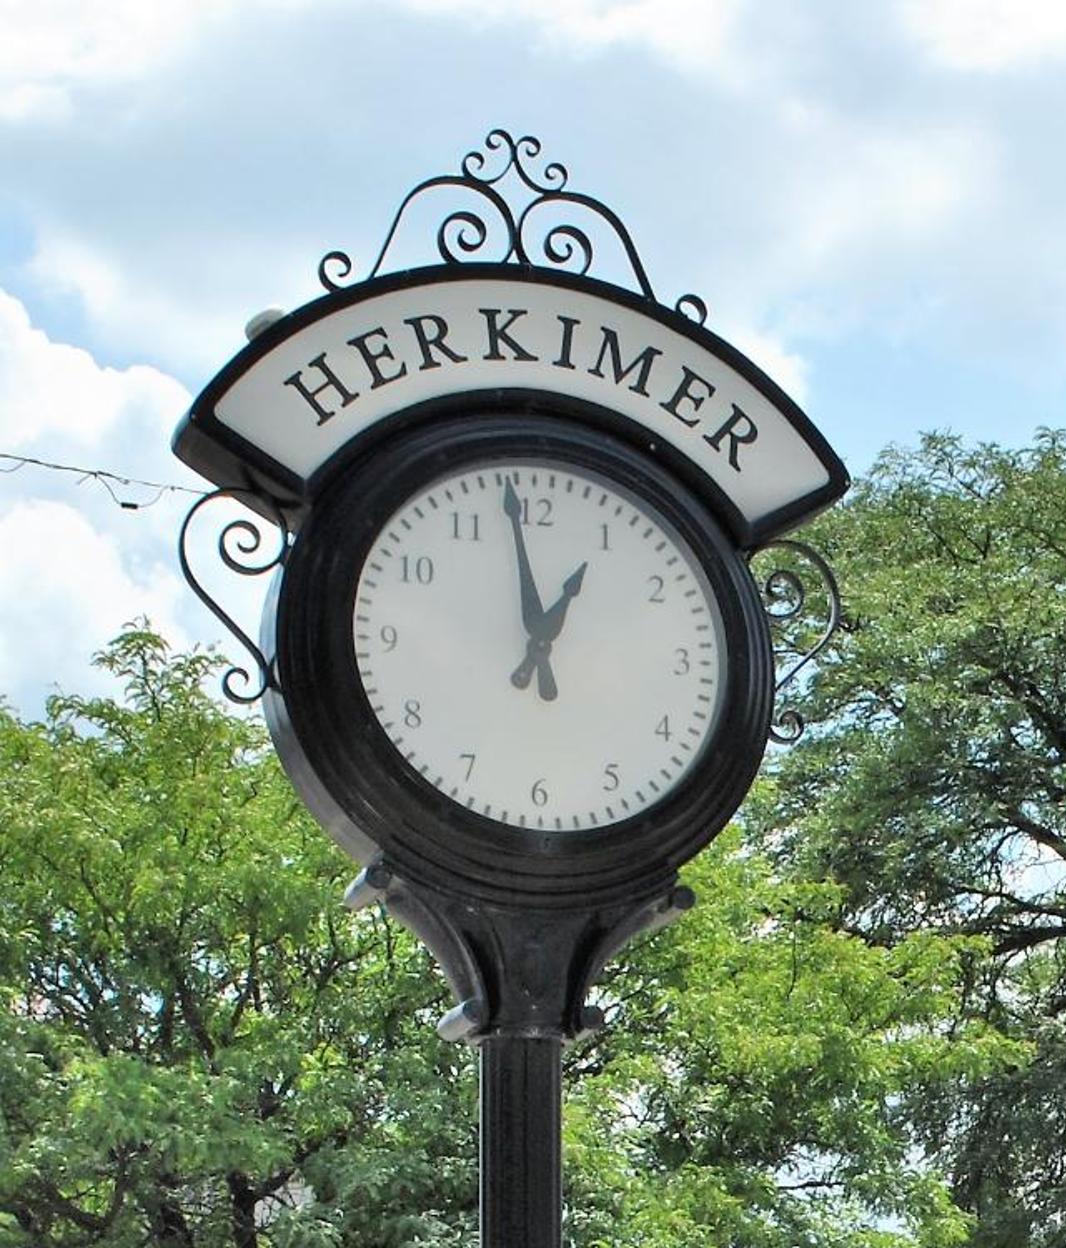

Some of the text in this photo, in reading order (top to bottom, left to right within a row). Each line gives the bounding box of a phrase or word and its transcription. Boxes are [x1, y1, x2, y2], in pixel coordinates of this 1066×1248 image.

[284, 307, 759, 473] HERKIMER
[451, 511, 483, 542] 11
[520, 496, 554, 527] 12
[600, 523, 612, 551] 1
[400, 554, 434, 585] 10
[648, 574, 666, 604] 2
[380, 625, 398, 654] 9
[673, 647, 691, 676] 3
[404, 699, 422, 729] 8
[654, 714, 672, 743] 4
[459, 752, 477, 783] 7
[602, 762, 620, 792] 5
[531, 777, 549, 808] 6
